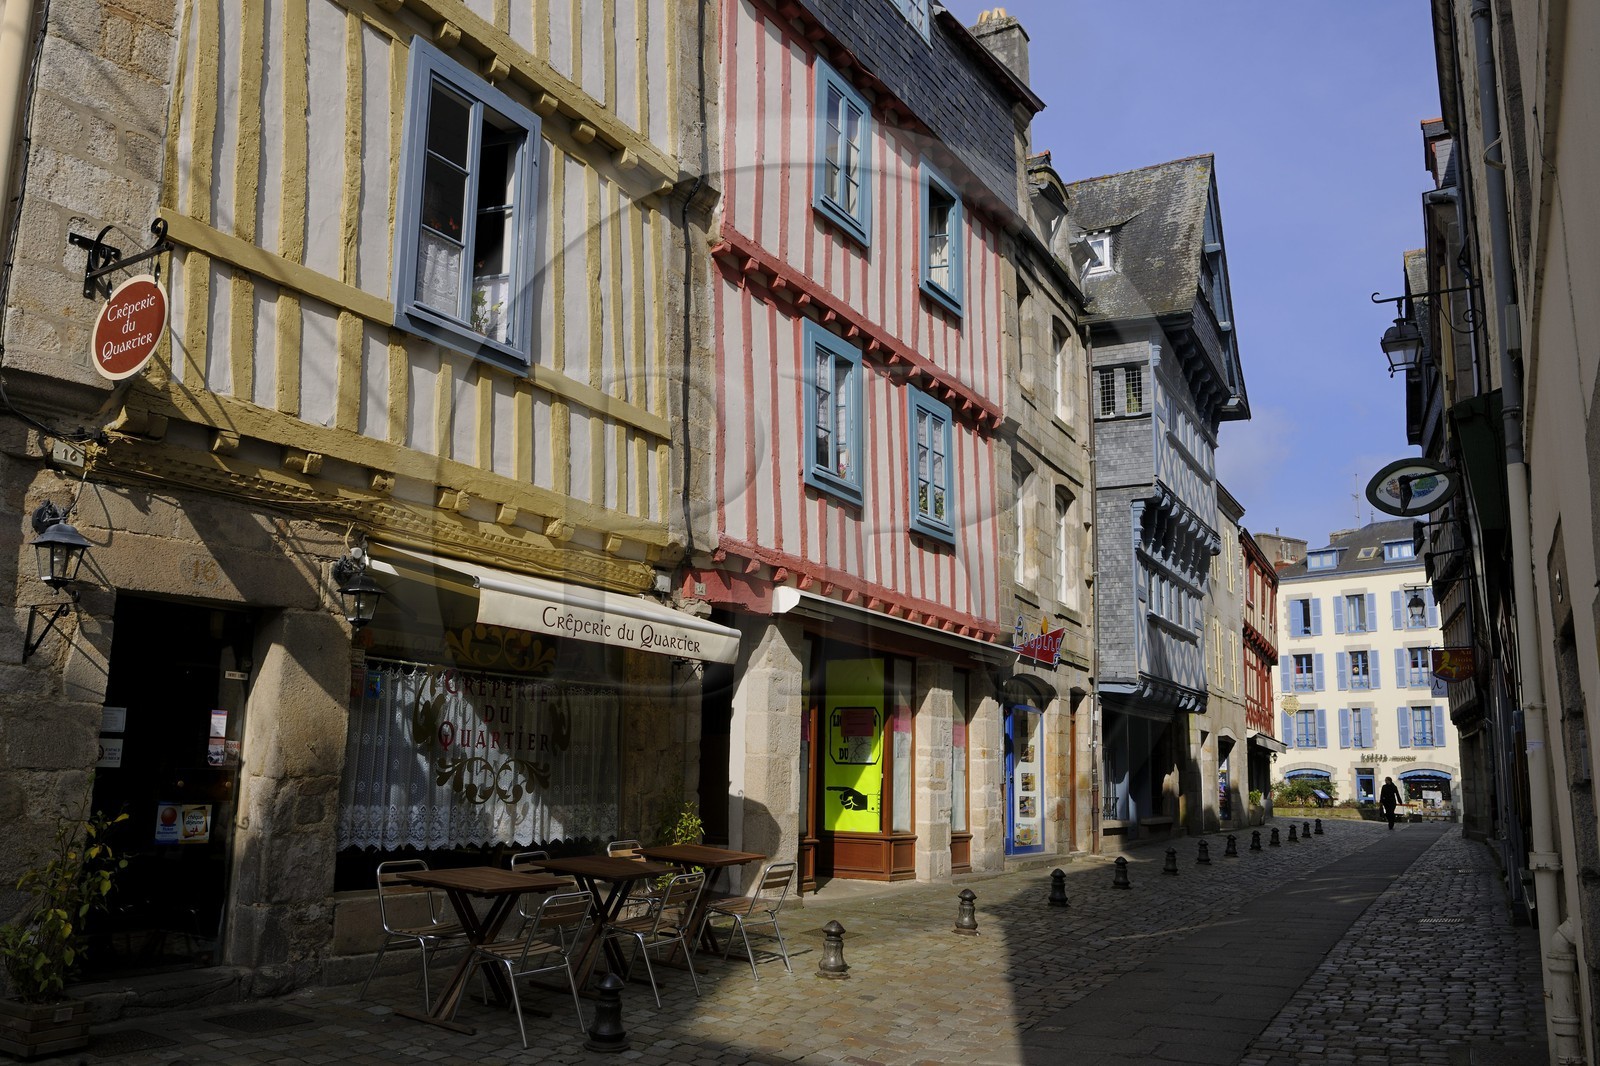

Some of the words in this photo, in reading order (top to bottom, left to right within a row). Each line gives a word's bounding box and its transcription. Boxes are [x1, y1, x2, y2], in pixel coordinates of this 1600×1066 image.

[107, 293, 156, 322] Crêperie
[122, 319, 136, 335] du
[102, 332, 153, 363] Quartier
[62, 447, 78, 463] 16
[192, 559, 218, 582] 16
[542, 605, 611, 638] Crêperie
[617, 622, 634, 642] du
[640, 623, 701, 653] Quartier
[484, 704, 511, 724] DU
